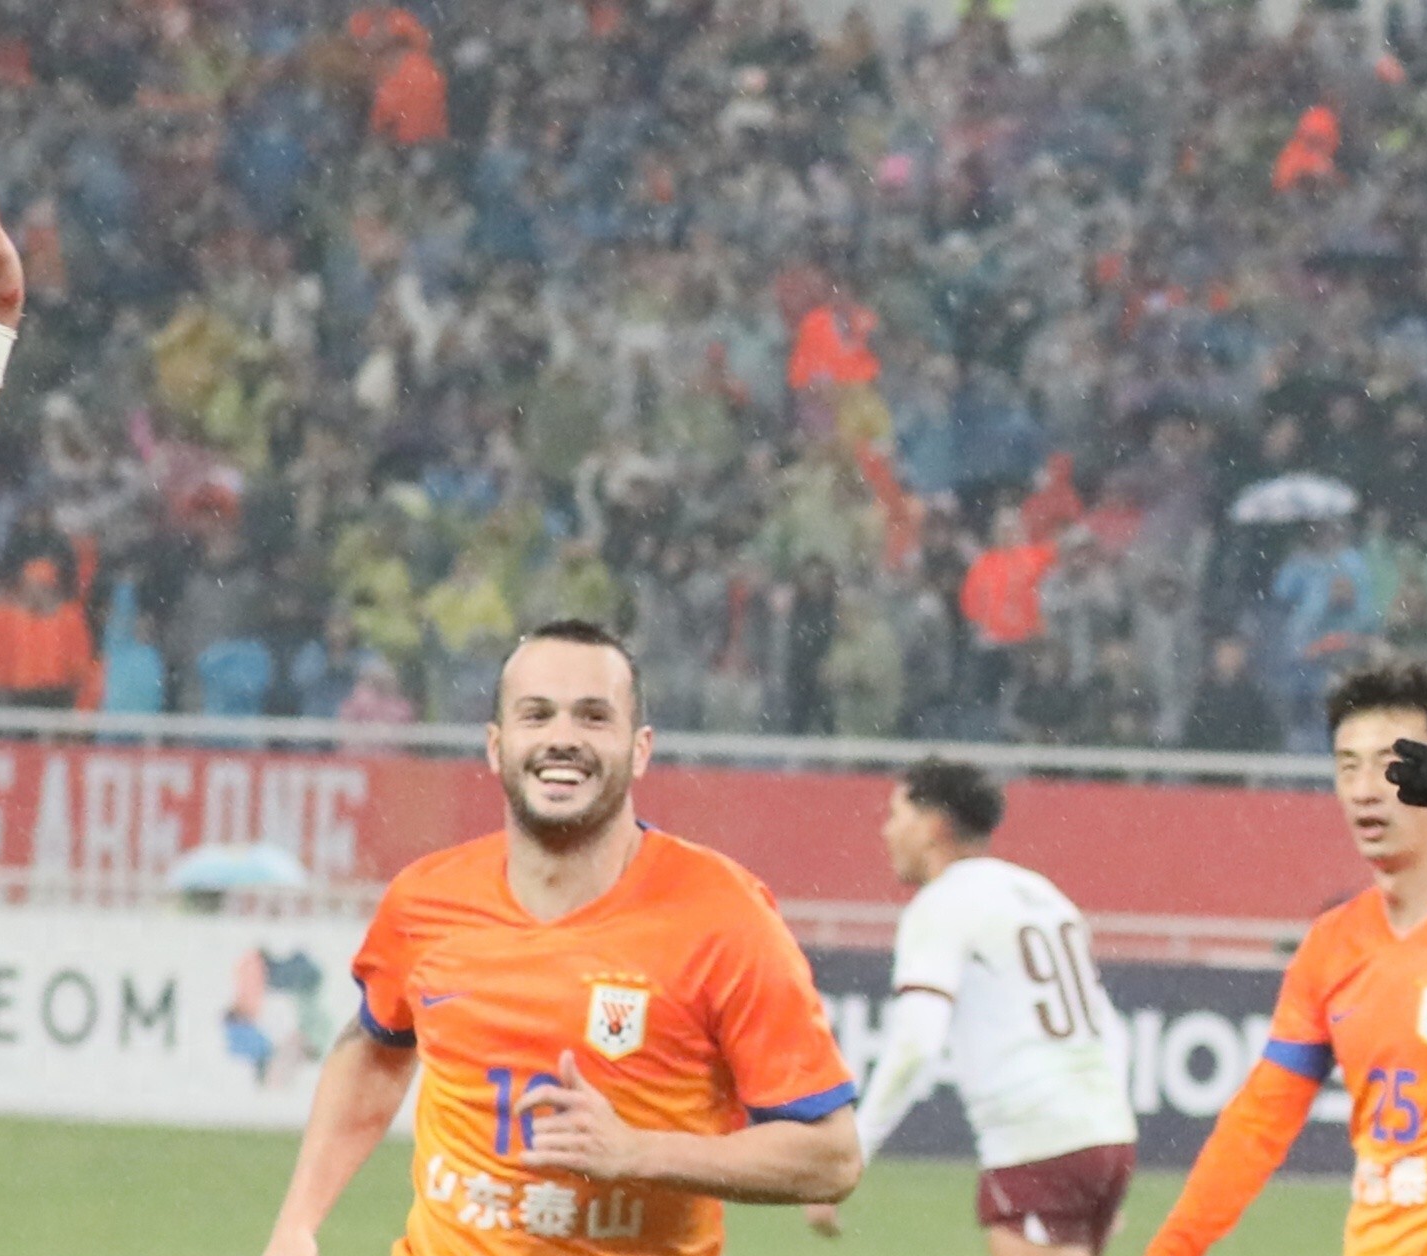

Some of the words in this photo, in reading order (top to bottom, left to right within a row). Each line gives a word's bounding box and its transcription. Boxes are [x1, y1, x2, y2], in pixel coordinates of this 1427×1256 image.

[28, 754, 194, 905] ARE
[204, 761, 368, 908] ONE
[1368, 1067, 1421, 1144] 25
